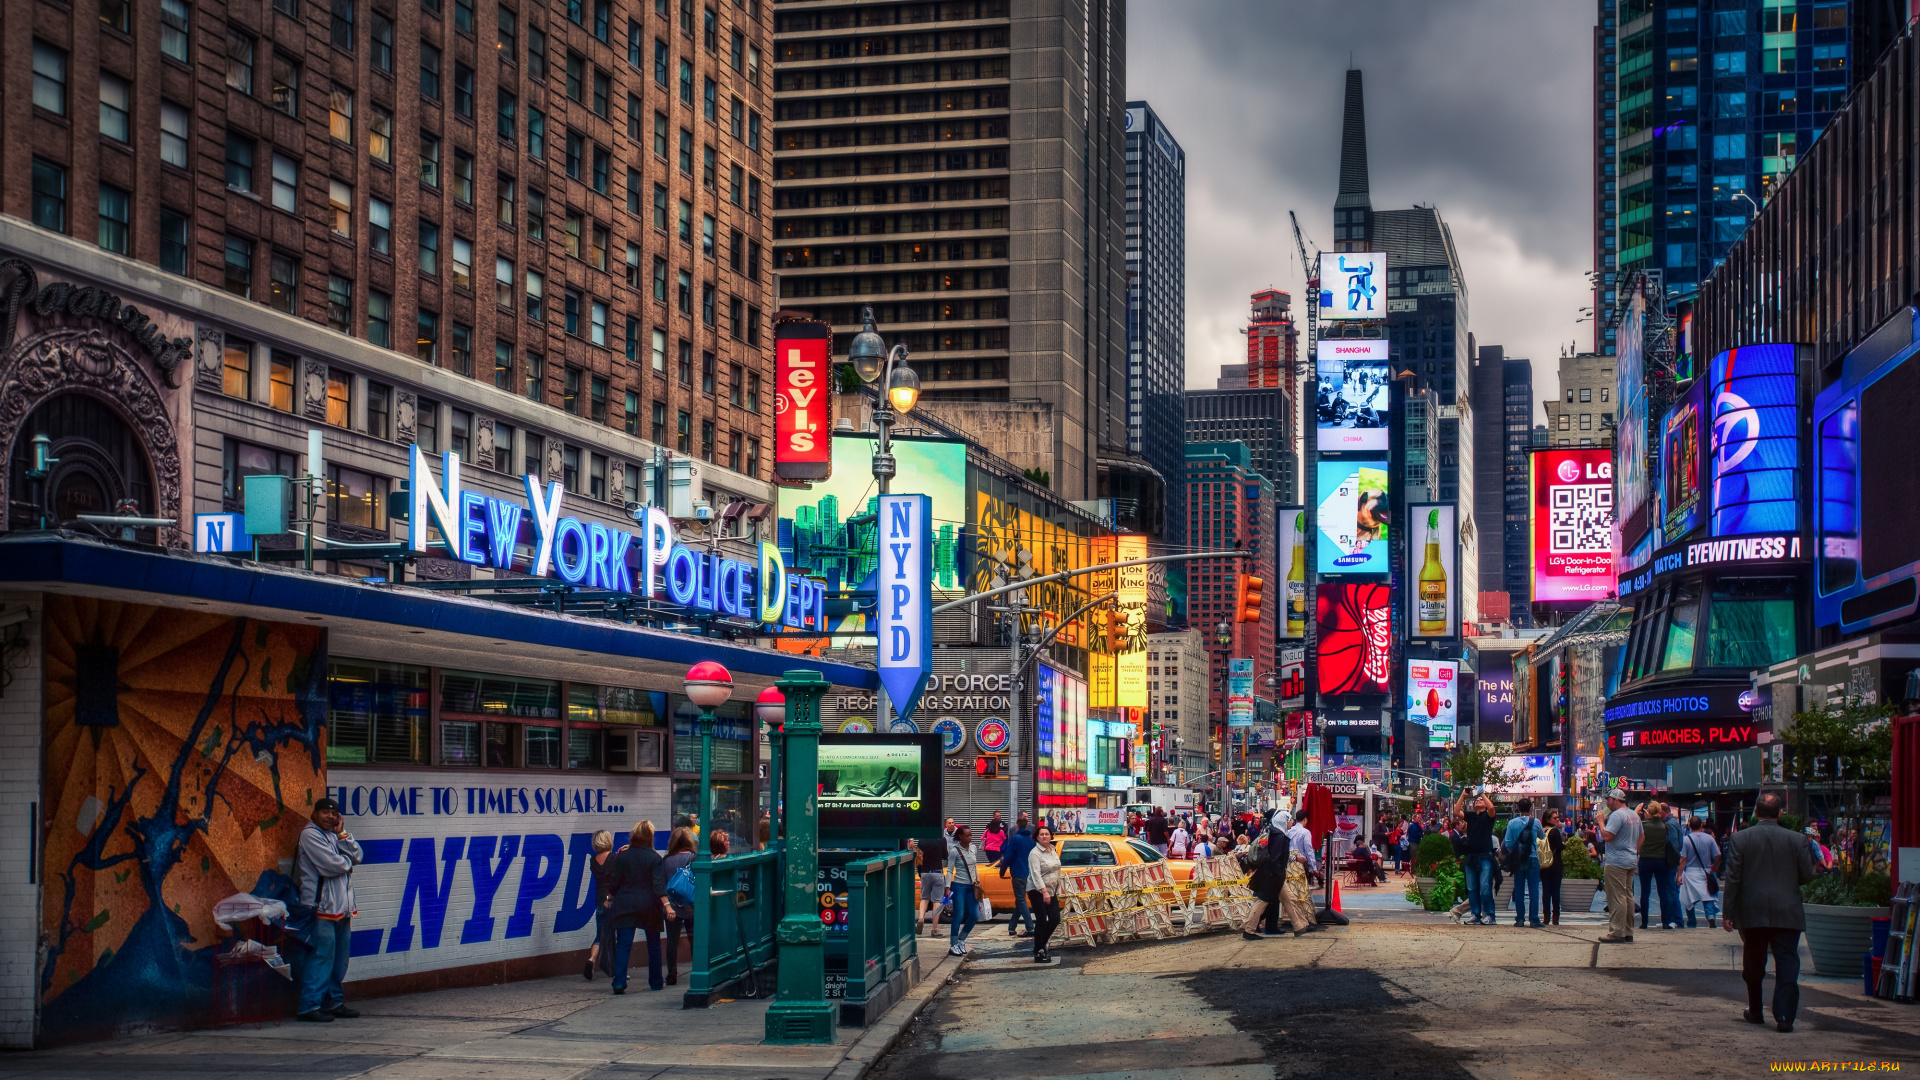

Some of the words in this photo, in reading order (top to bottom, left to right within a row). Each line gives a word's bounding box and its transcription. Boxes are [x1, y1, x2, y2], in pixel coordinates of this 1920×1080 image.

[1586, 463, 1612, 479] LG
[1687, 537, 1786, 566] EYEWITNESS
[1549, 557, 1565, 565] LG's
[1566, 557, 1612, 565] Door-in-Doo
[1654, 552, 1682, 575] WATCH
[1121, 565, 1142, 576] LION
[1564, 566, 1606, 575] Refrigerator
[889, 502, 912, 662] NYPD
[1120, 577, 1145, 589] KING
[1288, 581, 1304, 589] Coro
[1440, 670, 1451, 678] Gift
[1478, 680, 1497, 690] The
[942, 696, 1012, 710] STATION
[1487, 693, 1497, 703] Is
[1738, 696, 1751, 706] ab
[1638, 699, 1661, 716] BLOCKS
[1663, 696, 1709, 713] PHOTOS
[1651, 729, 1704, 745] COACHES,
[945, 759, 963, 767] RCE
[1697, 754, 1744, 788] SEPHORA
[1335, 785, 1356, 794] DOGS
[429, 787, 459, 816] TO
[464, 787, 529, 815] TIMES
[1098, 811, 1119, 819] Animal
[824, 912, 832, 921] 3
[841, 911, 848, 921] 7
[825, 982, 847, 990] dnight
